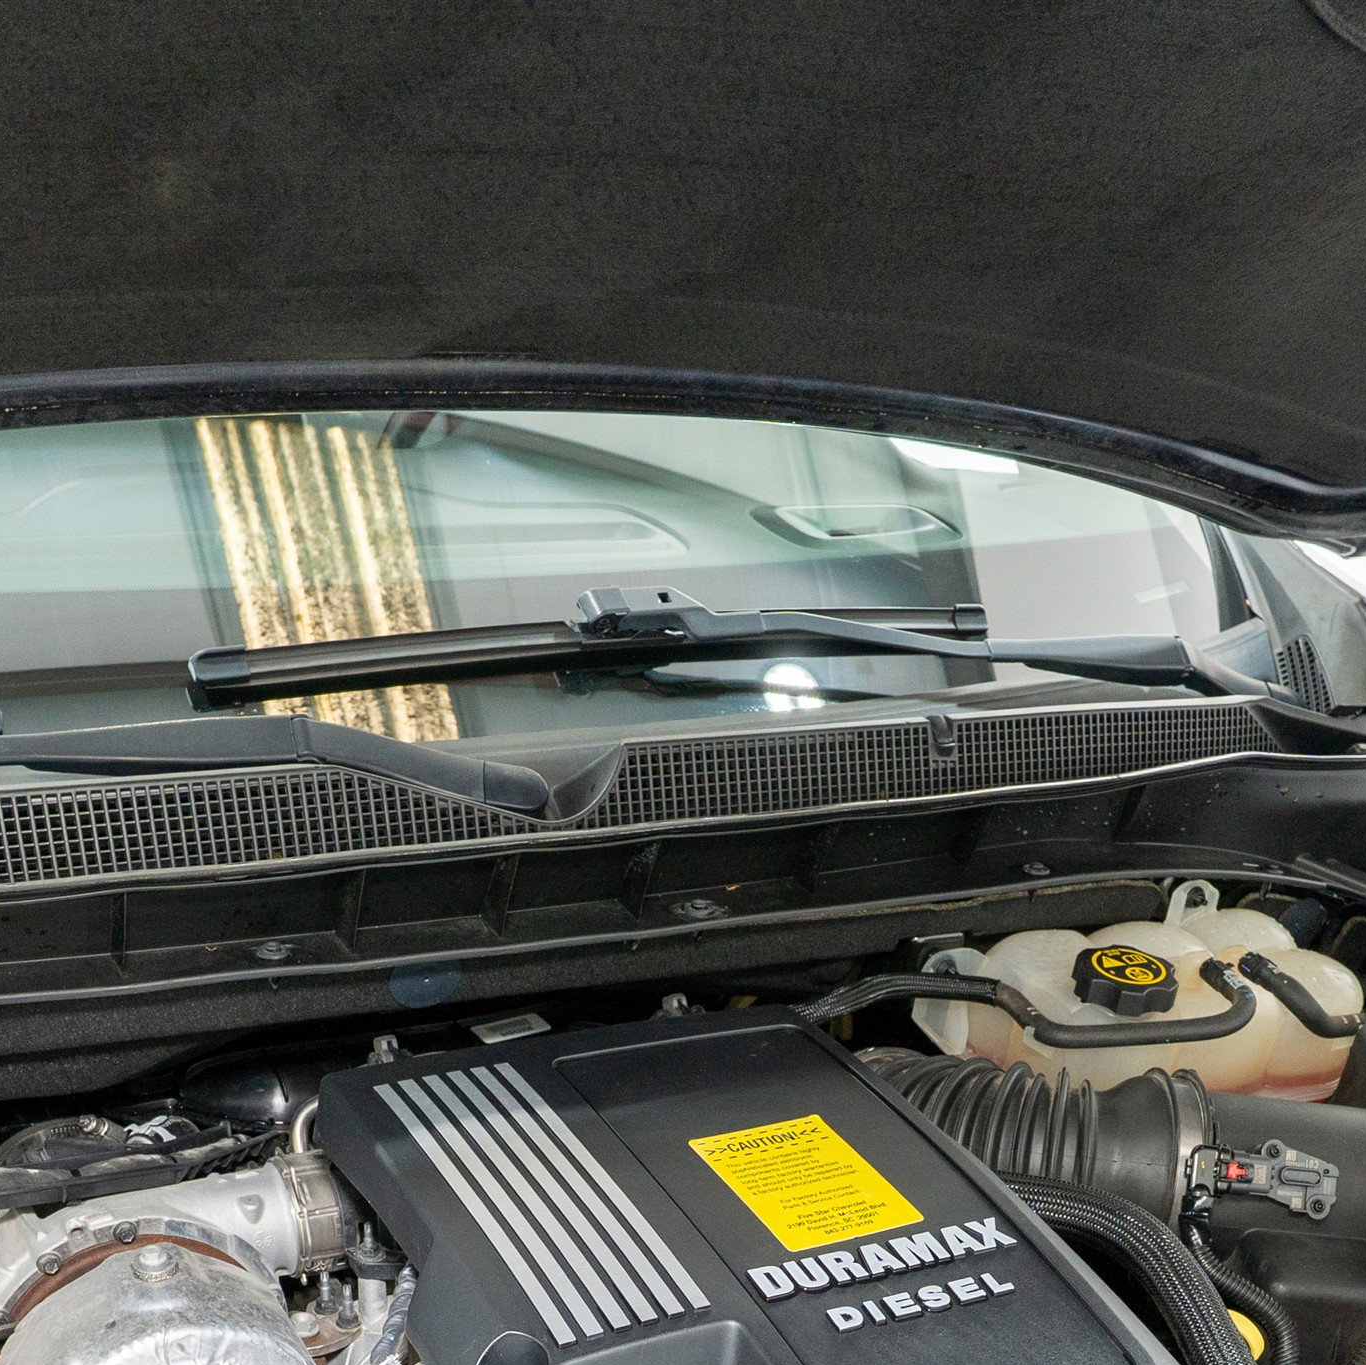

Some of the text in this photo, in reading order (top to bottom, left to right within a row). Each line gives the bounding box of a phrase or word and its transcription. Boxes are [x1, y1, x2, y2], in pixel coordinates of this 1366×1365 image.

[831, 1200, 867, 1211] Chevrolet
[745, 1217, 1017, 1302] DURAMAX
[825, 1272, 1016, 1333] DIESEL
